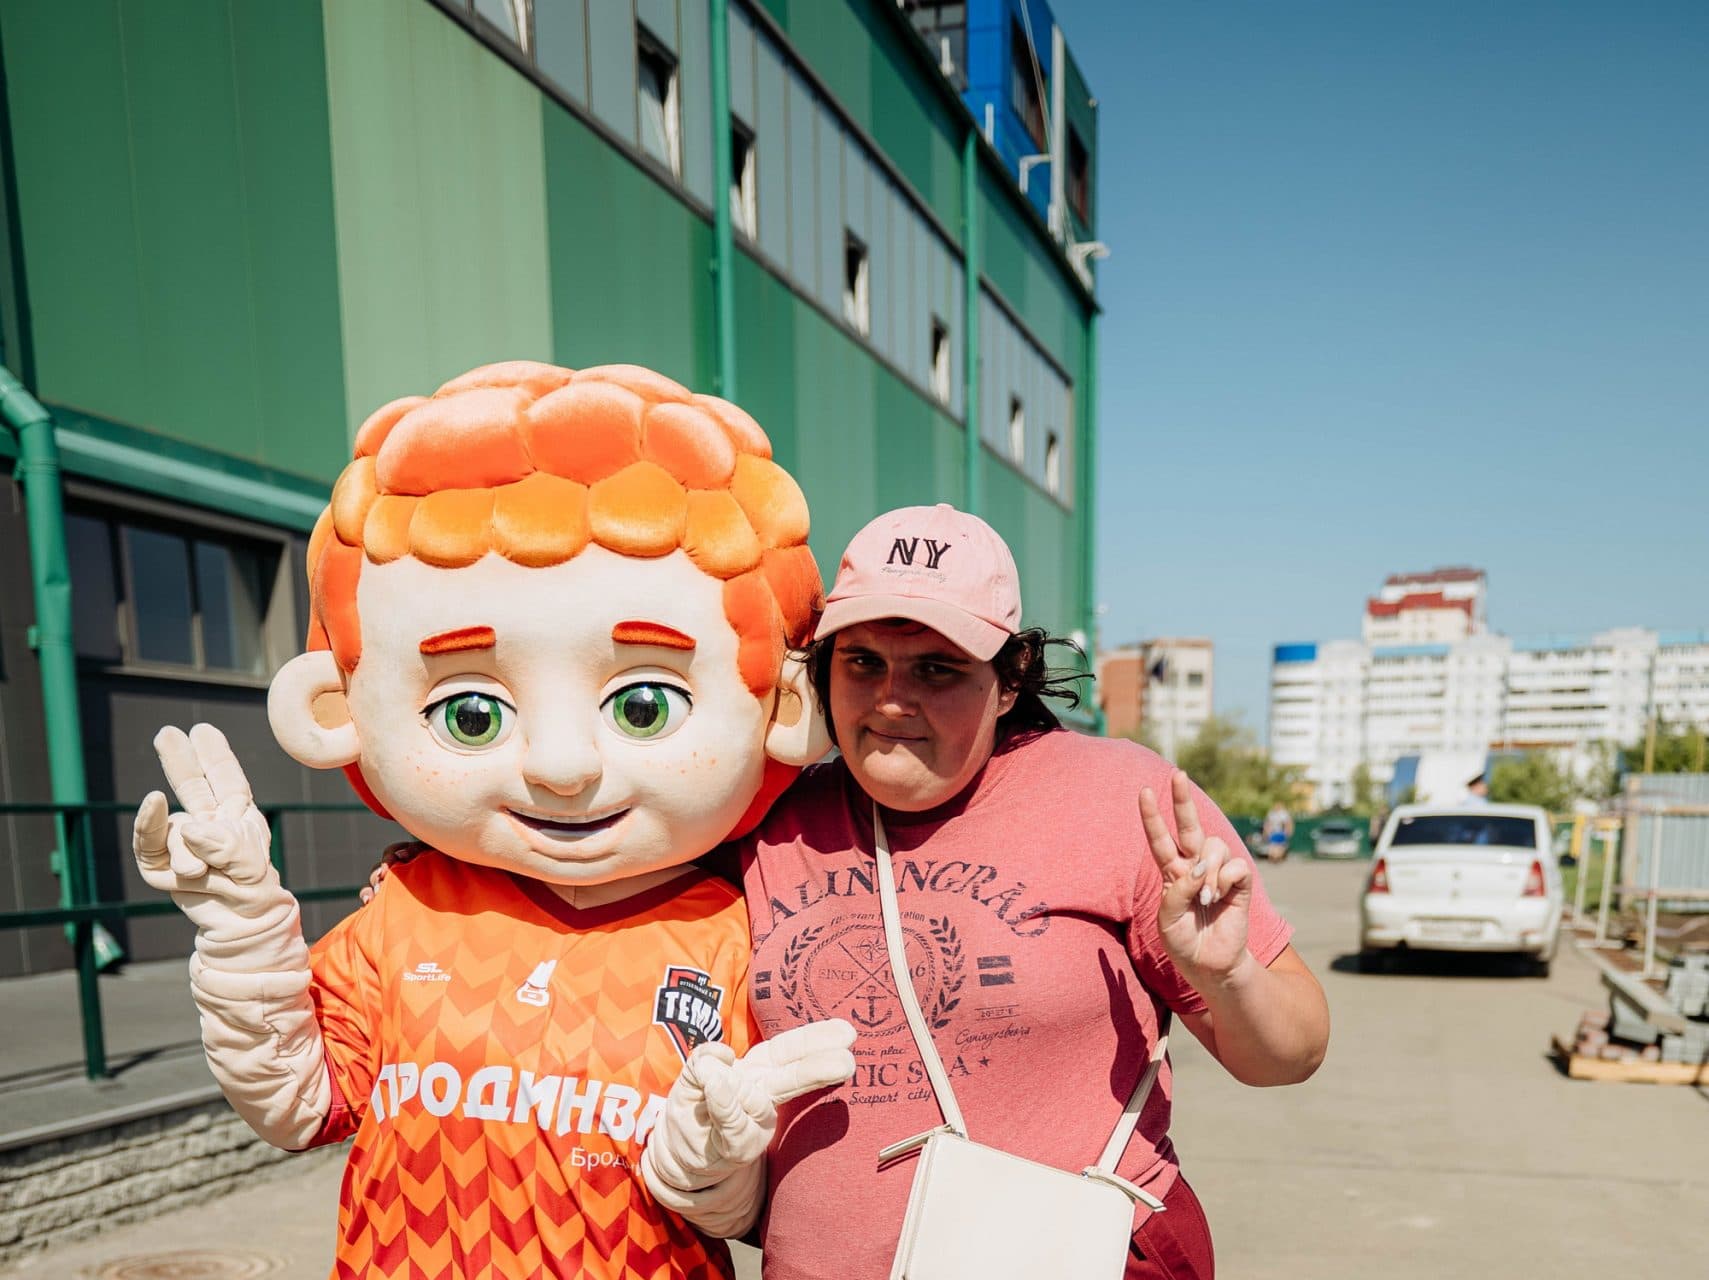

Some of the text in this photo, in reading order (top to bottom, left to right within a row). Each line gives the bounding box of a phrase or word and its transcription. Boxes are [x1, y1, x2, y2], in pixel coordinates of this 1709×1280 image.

[886, 536, 951, 569] NY
[819, 968, 858, 980] SINCE
[664, 991, 719, 1042] ТЕМП
[850, 1056, 972, 1088] TIC SA
